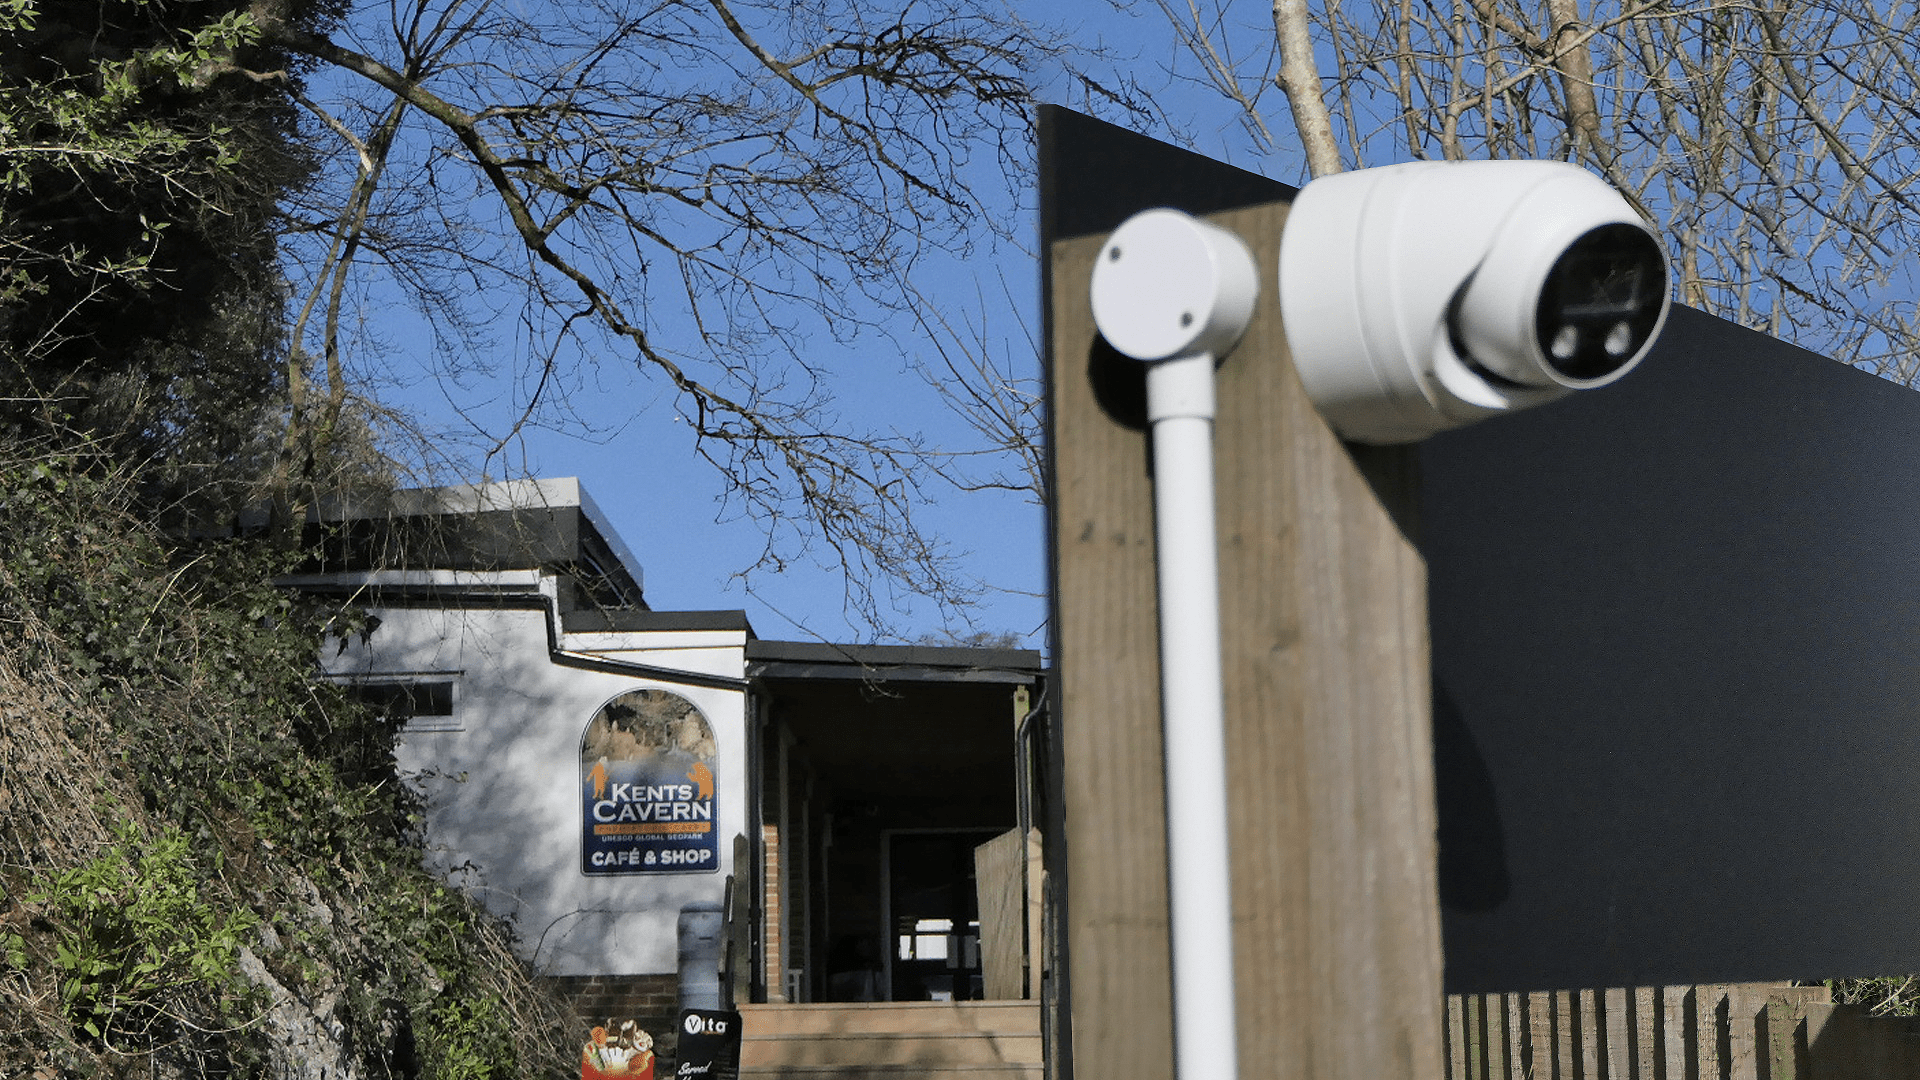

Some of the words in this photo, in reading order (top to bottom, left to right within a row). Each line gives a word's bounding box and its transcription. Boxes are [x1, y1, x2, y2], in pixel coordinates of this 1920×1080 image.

[612, 783, 693, 802] KENTS
[593, 800, 711, 822] CAVERN
[591, 847, 640, 866] CAFÉ
[644, 850, 657, 865] &
[660, 848, 711, 865] SHOP
